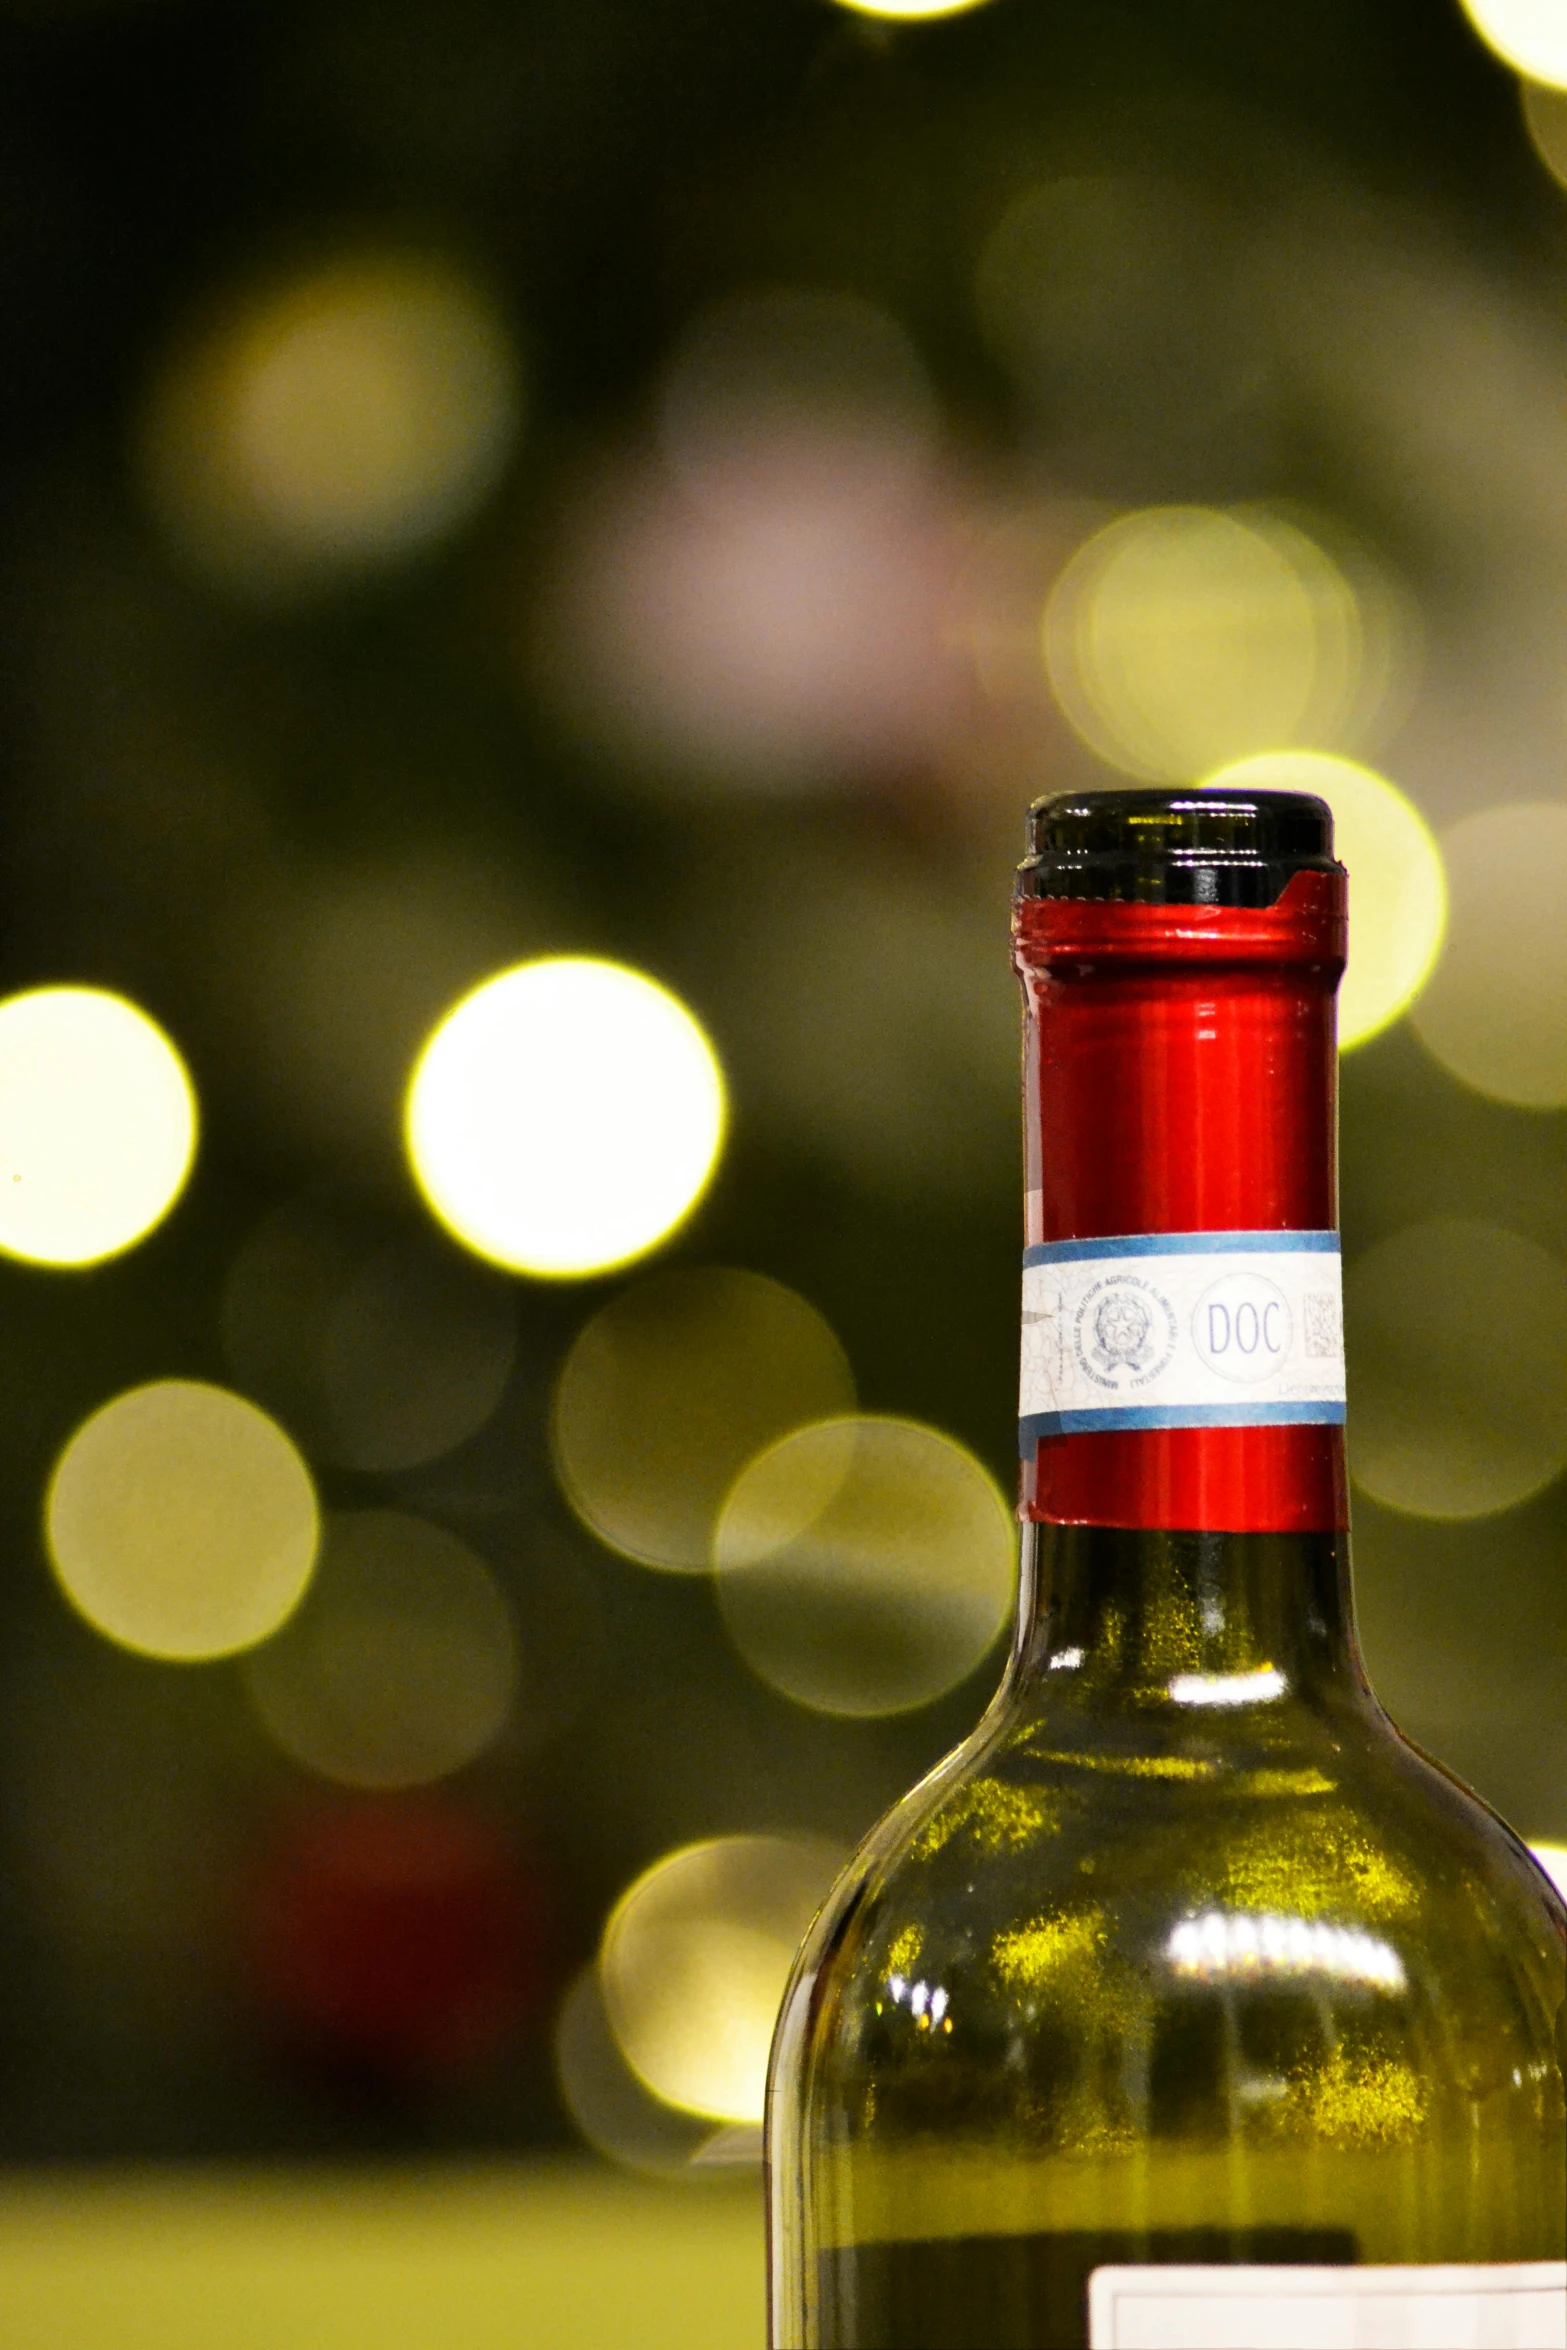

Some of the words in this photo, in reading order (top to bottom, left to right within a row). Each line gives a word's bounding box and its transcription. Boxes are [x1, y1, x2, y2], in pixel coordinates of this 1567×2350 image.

[1075, 1281, 1102, 1324] POLITICHE
[1105, 1275, 1149, 1288] AGRICOLE
[1208, 1302, 1281, 1355] DOC
